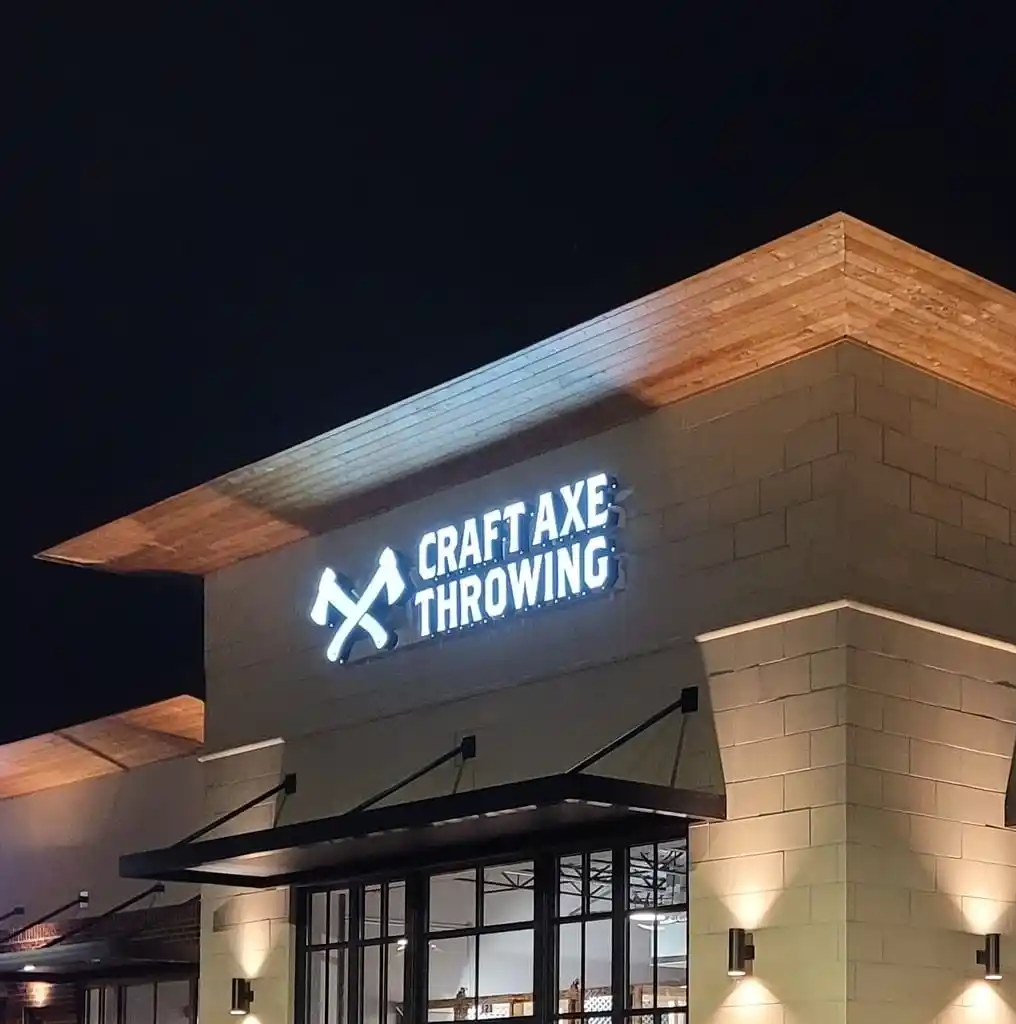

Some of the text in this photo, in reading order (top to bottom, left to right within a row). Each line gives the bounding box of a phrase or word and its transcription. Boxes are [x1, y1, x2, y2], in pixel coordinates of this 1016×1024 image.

[418, 473, 609, 581] CRAFT AXE
[414, 535, 610, 637] THROWING
